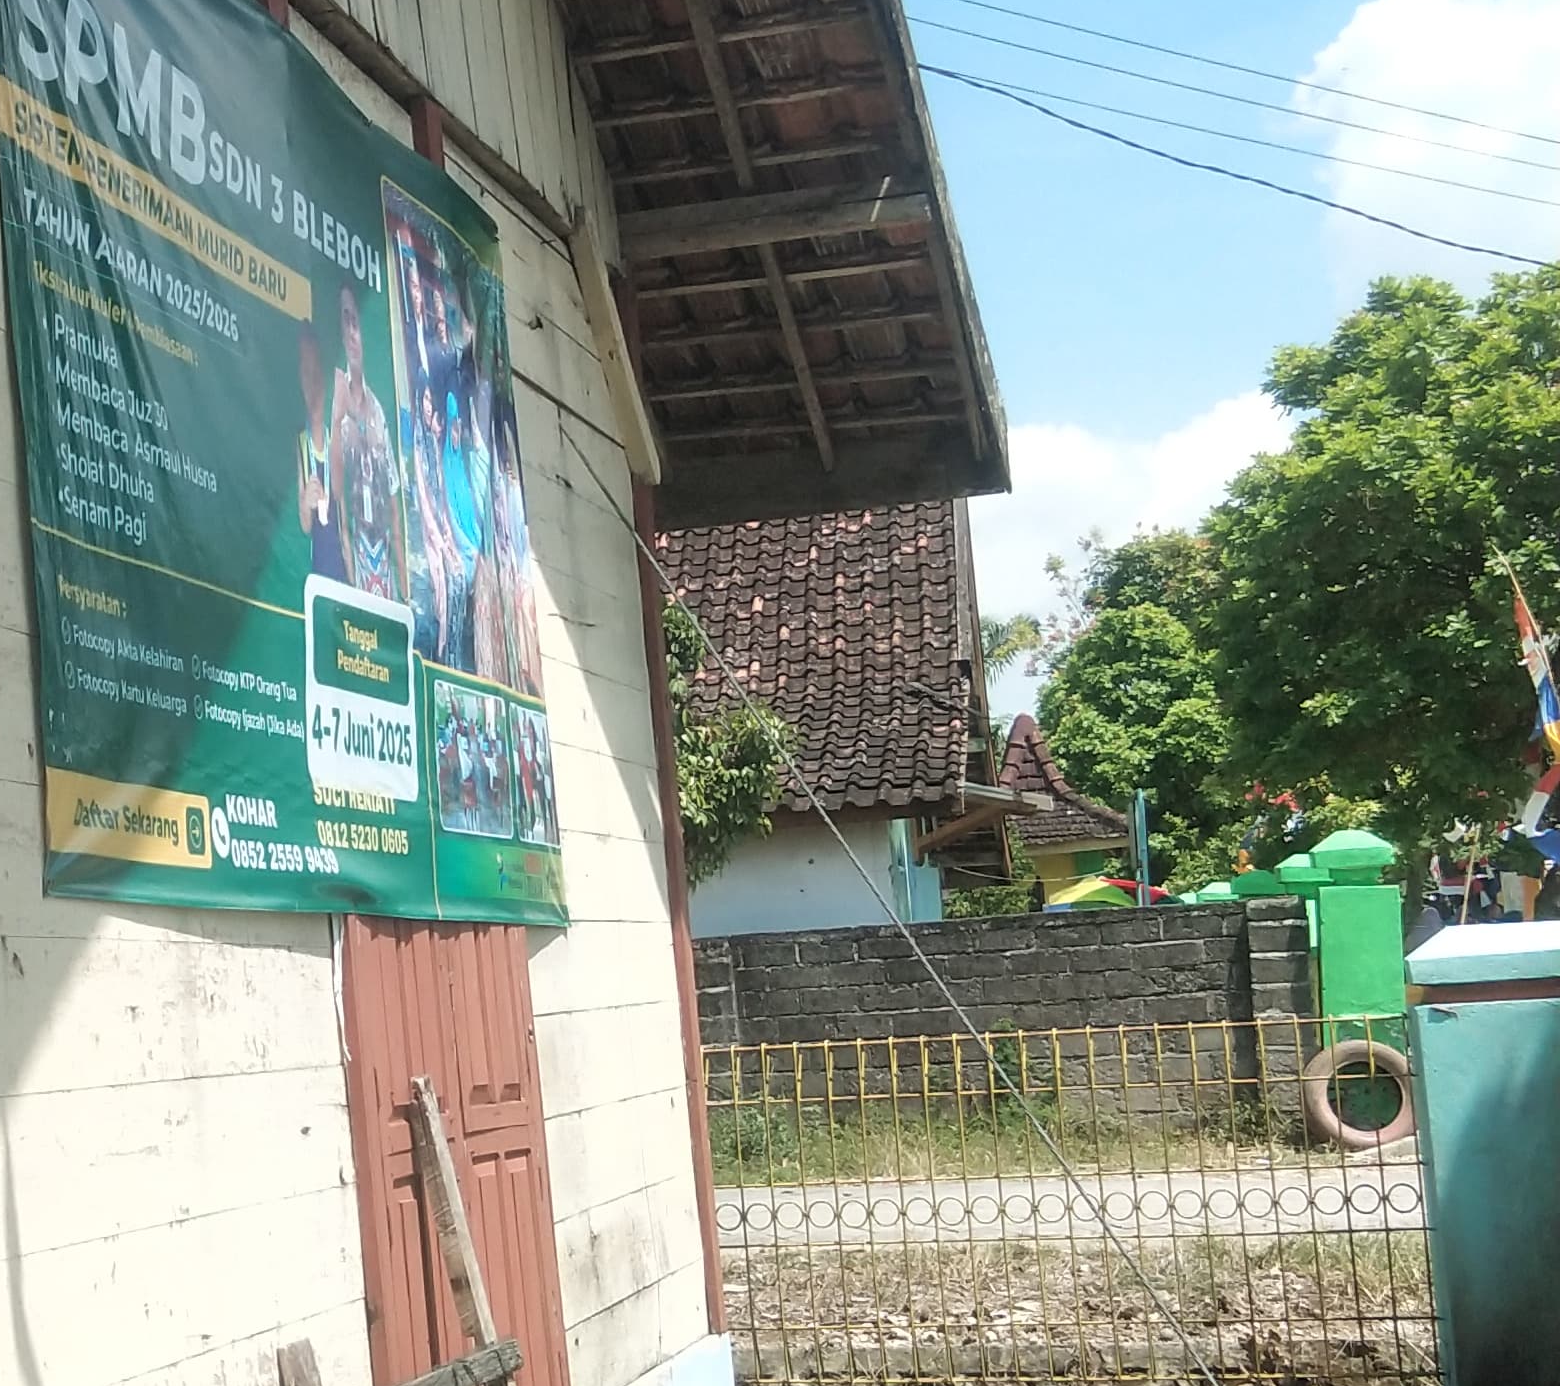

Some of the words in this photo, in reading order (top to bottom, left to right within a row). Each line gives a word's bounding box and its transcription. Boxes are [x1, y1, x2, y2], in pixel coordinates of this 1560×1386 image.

[86, 149, 194, 246] PENERIMAAN
[197, 219, 244, 277] MURID
[248, 257, 287, 303] BARU
[209, 131, 262, 210] SDN
[271, 174, 283, 224] 3
[292, 190, 382, 294] BLEBOH
[24, 187, 90, 255] TAHUN
[166, 274, 239, 342] 2025/2026
[55, 313, 118, 370] Pramuka
[55, 356, 126, 412] Membaca
[127, 390, 152, 424] Juz
[154, 401, 169, 431] 30
[57, 399, 128, 453] Membaca
[135, 433, 181, 476] Asmaul
[182, 453, 217, 493] Husna
[60, 444, 105, 487] Sholat
[108, 461, 154, 503] Dhuha
[63, 486, 111, 530] Senam
[115, 506, 147, 546] Pagi
[73, 624, 115, 660] Fotocopy
[118, 638, 139, 662] Akta
[139, 644, 184, 672] Kelahiran
[343, 620, 378, 652] Tanggal
[202, 660, 239, 692] Fotocopy
[239, 671, 255, 691] KTP
[256, 675, 281, 702] Orang
[281, 681, 297, 701] Tua
[337, 649, 390, 683] Pendaftaran
[77, 668, 120, 703] Fotocopy
[121, 678, 145, 704] Kartu
[146, 685, 187, 717] Keluarga
[204, 700, 241, 732] Fotocopy
[286, 718, 304, 743] Ada)
[344, 710, 375, 760] Juni
[377, 718, 412, 767] 2025
[73, 798, 119, 831] Daftar
[123, 805, 179, 846] Sekarang
[225, 793, 278, 829] KOHAR
[231, 838, 267, 870] 0852
[268, 842, 303, 873] 2559
[304, 846, 339, 874] 9439
[317, 820, 349, 848] 0812
[350, 823, 379, 851] 5230
[381, 827, 409, 855] 0605
